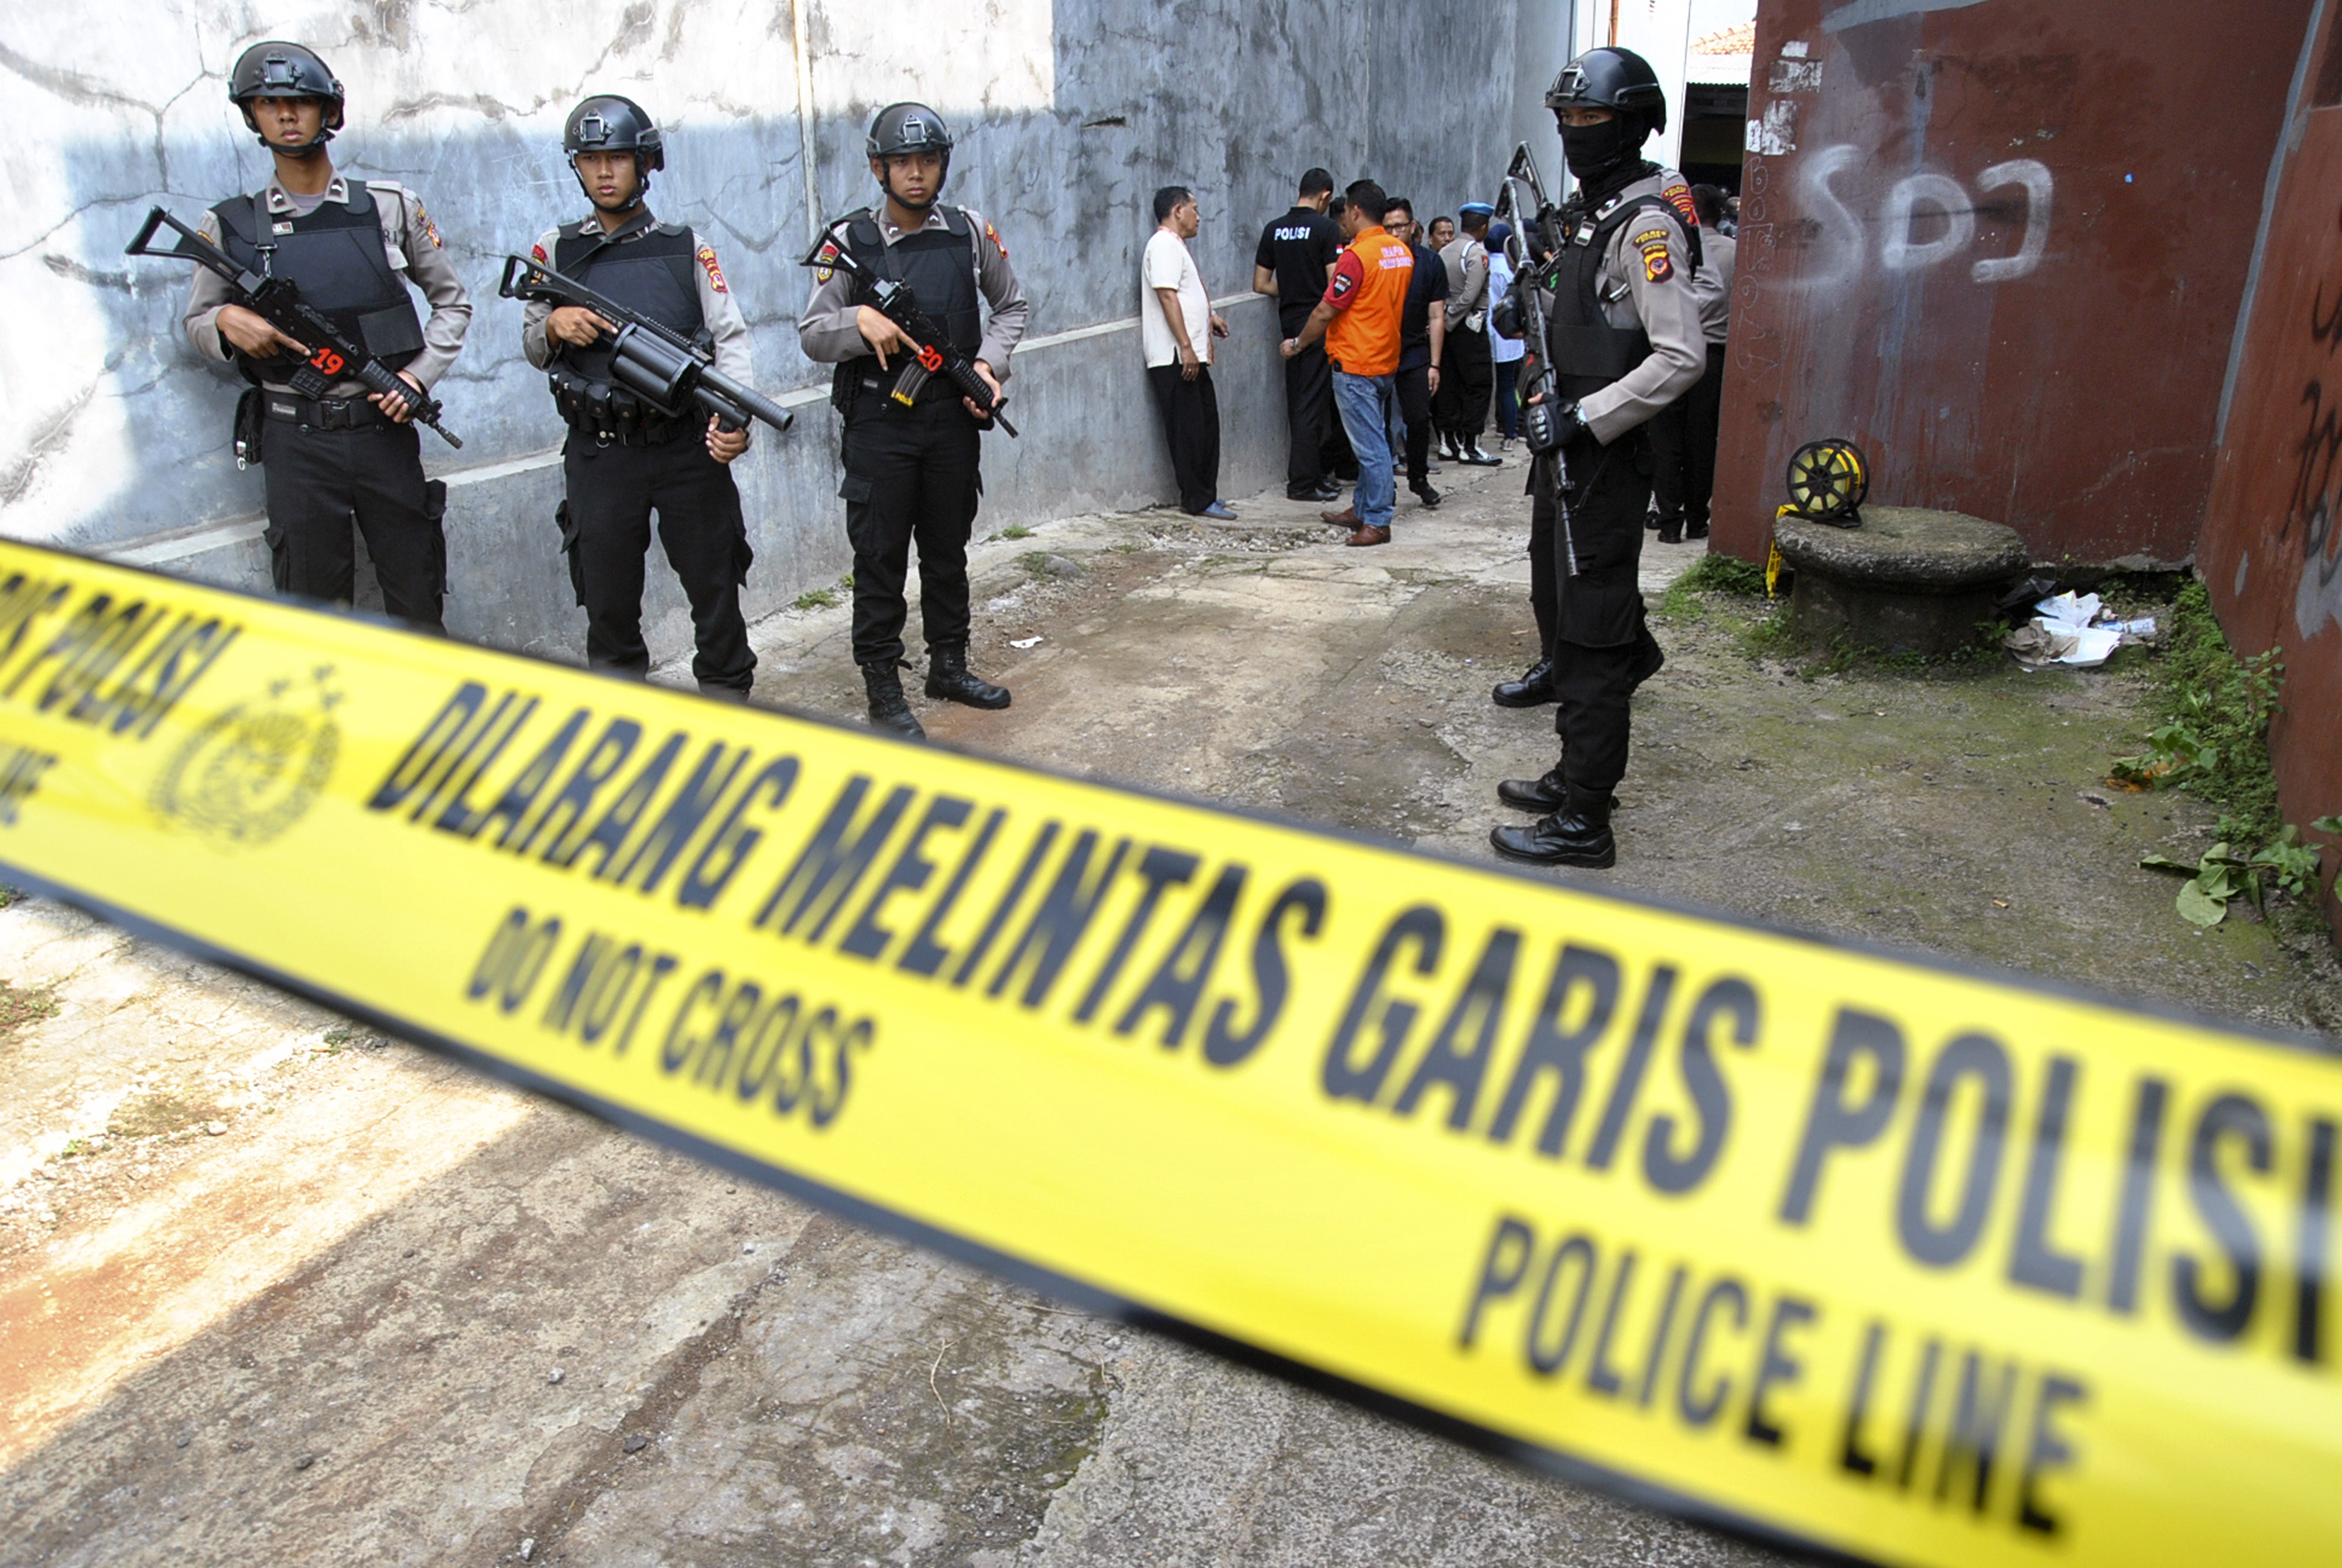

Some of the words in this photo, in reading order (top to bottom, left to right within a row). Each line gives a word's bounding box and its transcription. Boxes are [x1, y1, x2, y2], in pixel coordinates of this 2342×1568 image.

[1275, 226, 1310, 241] POLISI
[310, 348, 344, 374] 19
[917, 344, 943, 371] 20
[2, 593, 245, 741] POLISI
[364, 679, 802, 912] DILARANG
[750, 773, 1330, 1070] MELINTAS
[1319, 900, 1764, 1199] GARIS
[1778, 1001, 2339, 1367] POLISI
[464, 905, 563, 1015] DO
[540, 931, 680, 1059] NOT
[658, 968, 876, 1134] CROSS
[1455, 1211, 1821, 1450] POLICE
[1834, 1315, 2097, 1535] LINE
